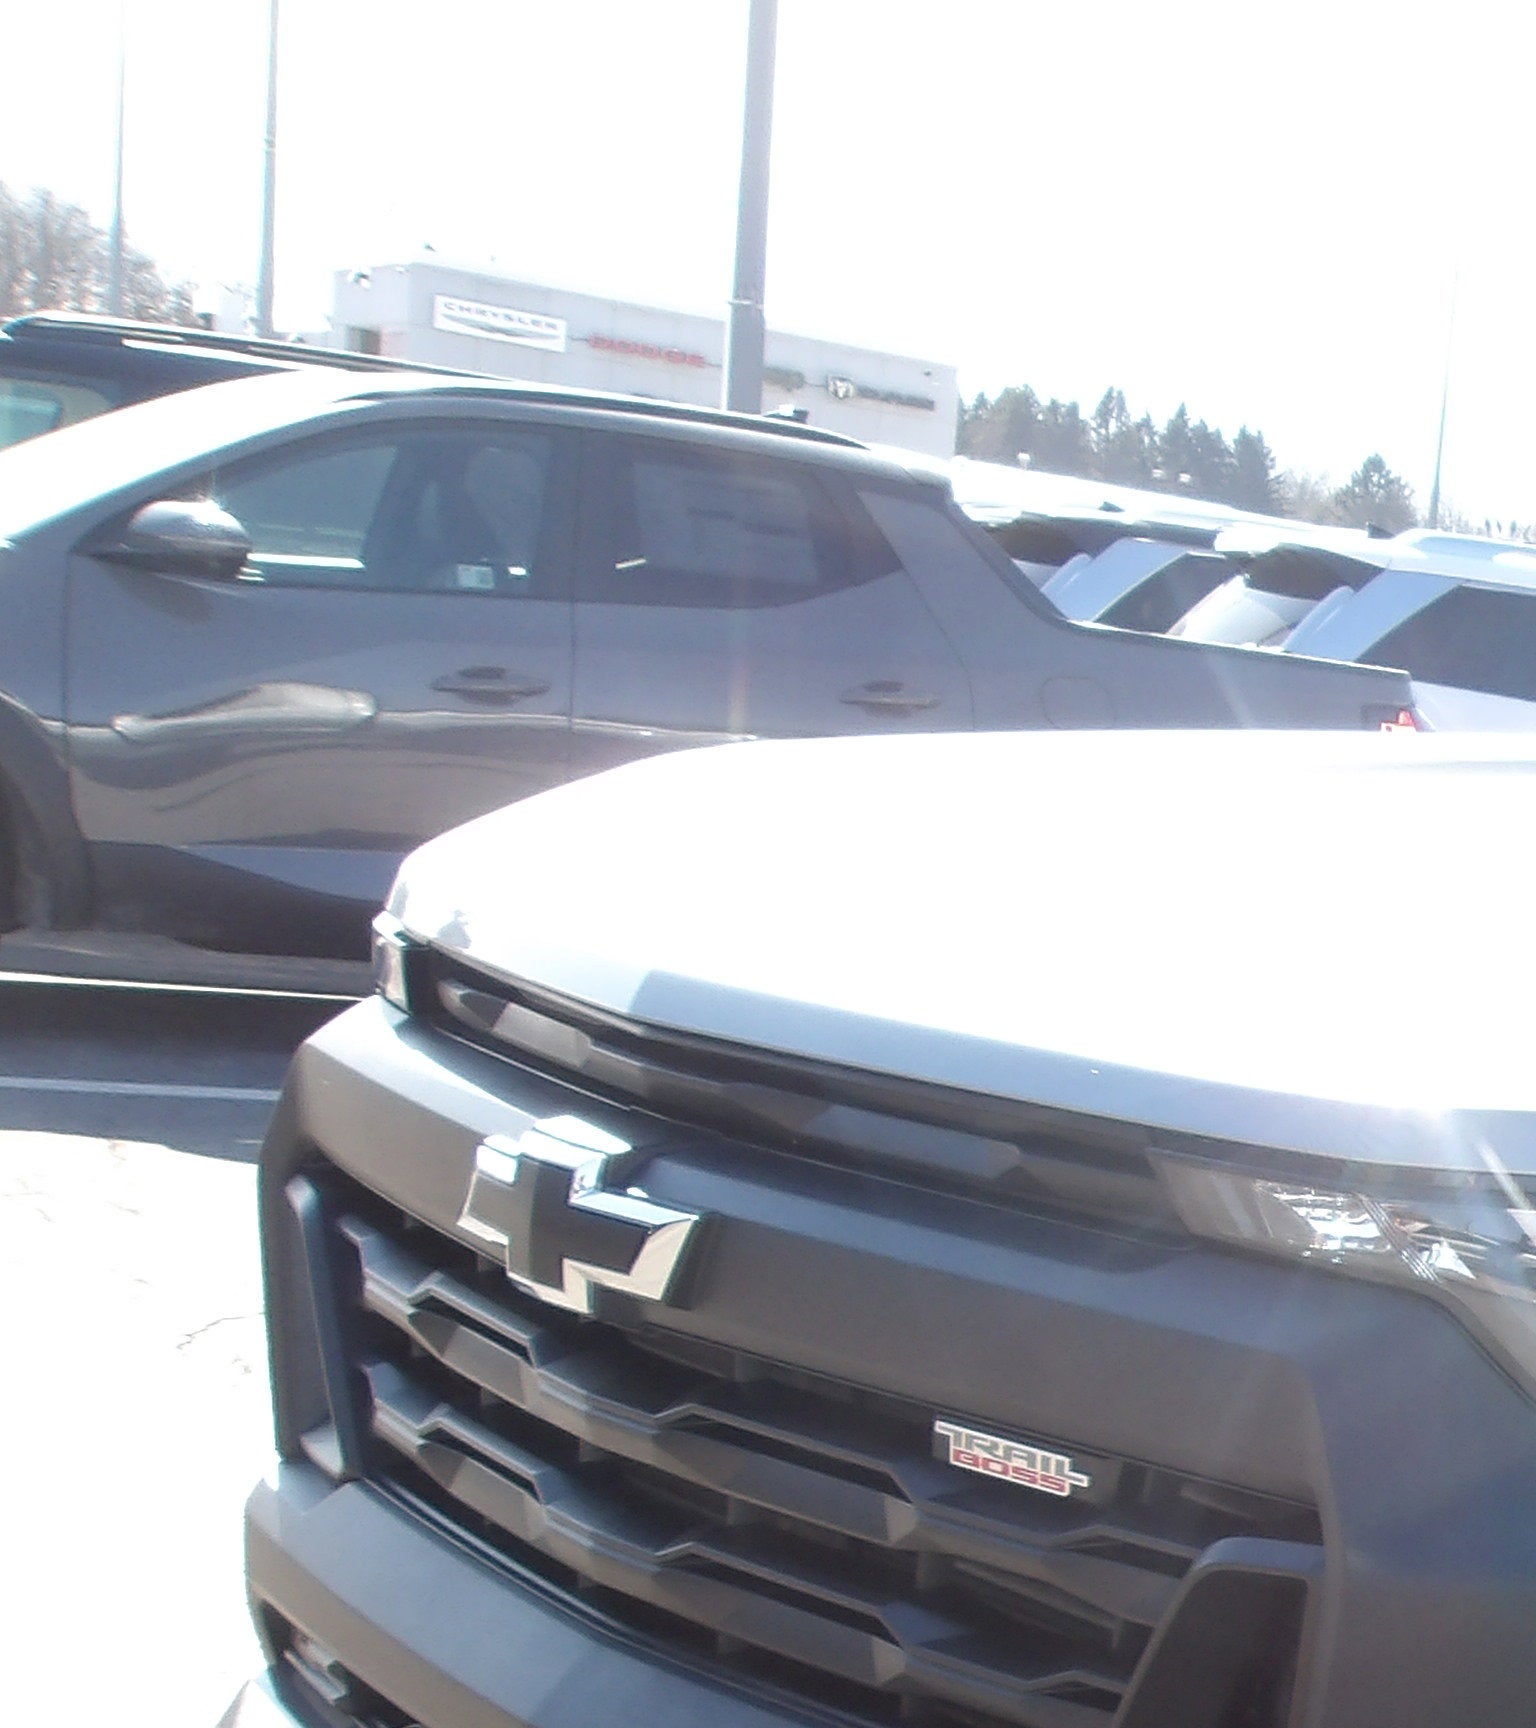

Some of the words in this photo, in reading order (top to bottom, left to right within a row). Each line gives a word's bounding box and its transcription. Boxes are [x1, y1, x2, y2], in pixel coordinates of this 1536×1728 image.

[443, 301, 559, 331] CHRYSLER
[589, 334, 706, 366] DODGE
[934, 1420, 1090, 1487] TRAIL
[951, 1447, 1069, 1495] BOSS
